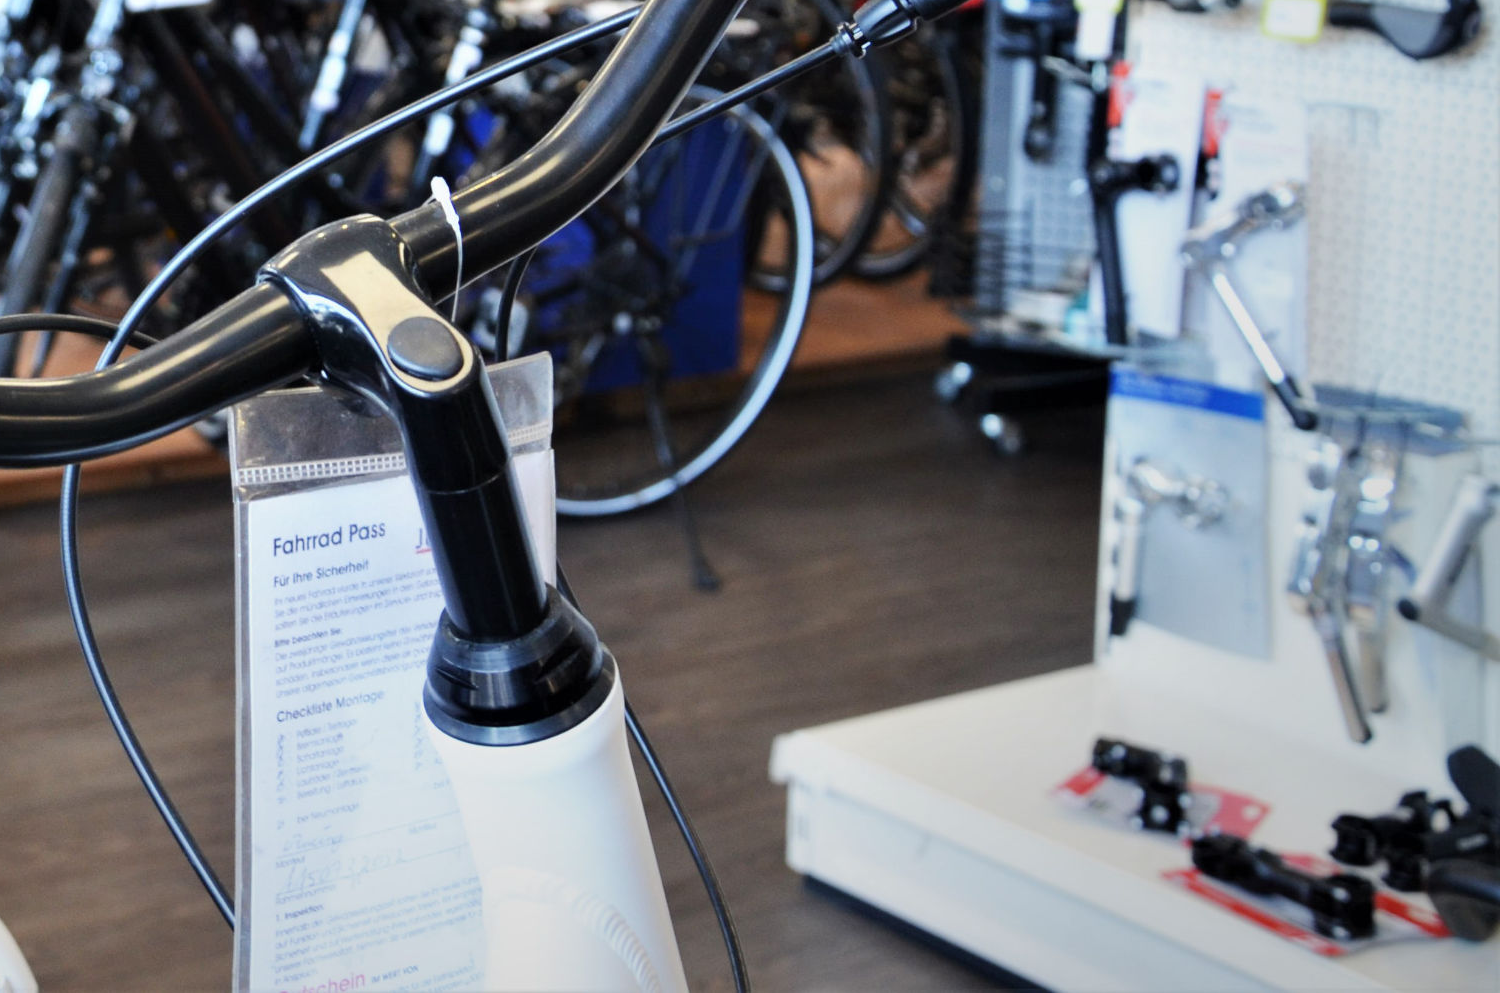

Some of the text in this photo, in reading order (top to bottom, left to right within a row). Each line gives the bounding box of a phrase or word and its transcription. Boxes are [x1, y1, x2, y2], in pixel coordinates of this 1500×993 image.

[273, 521, 387, 557] Fahrrad Pass
[273, 559, 369, 588] Für Ihre Sicherheit
[276, 689, 385, 723] Checkliste Montage
